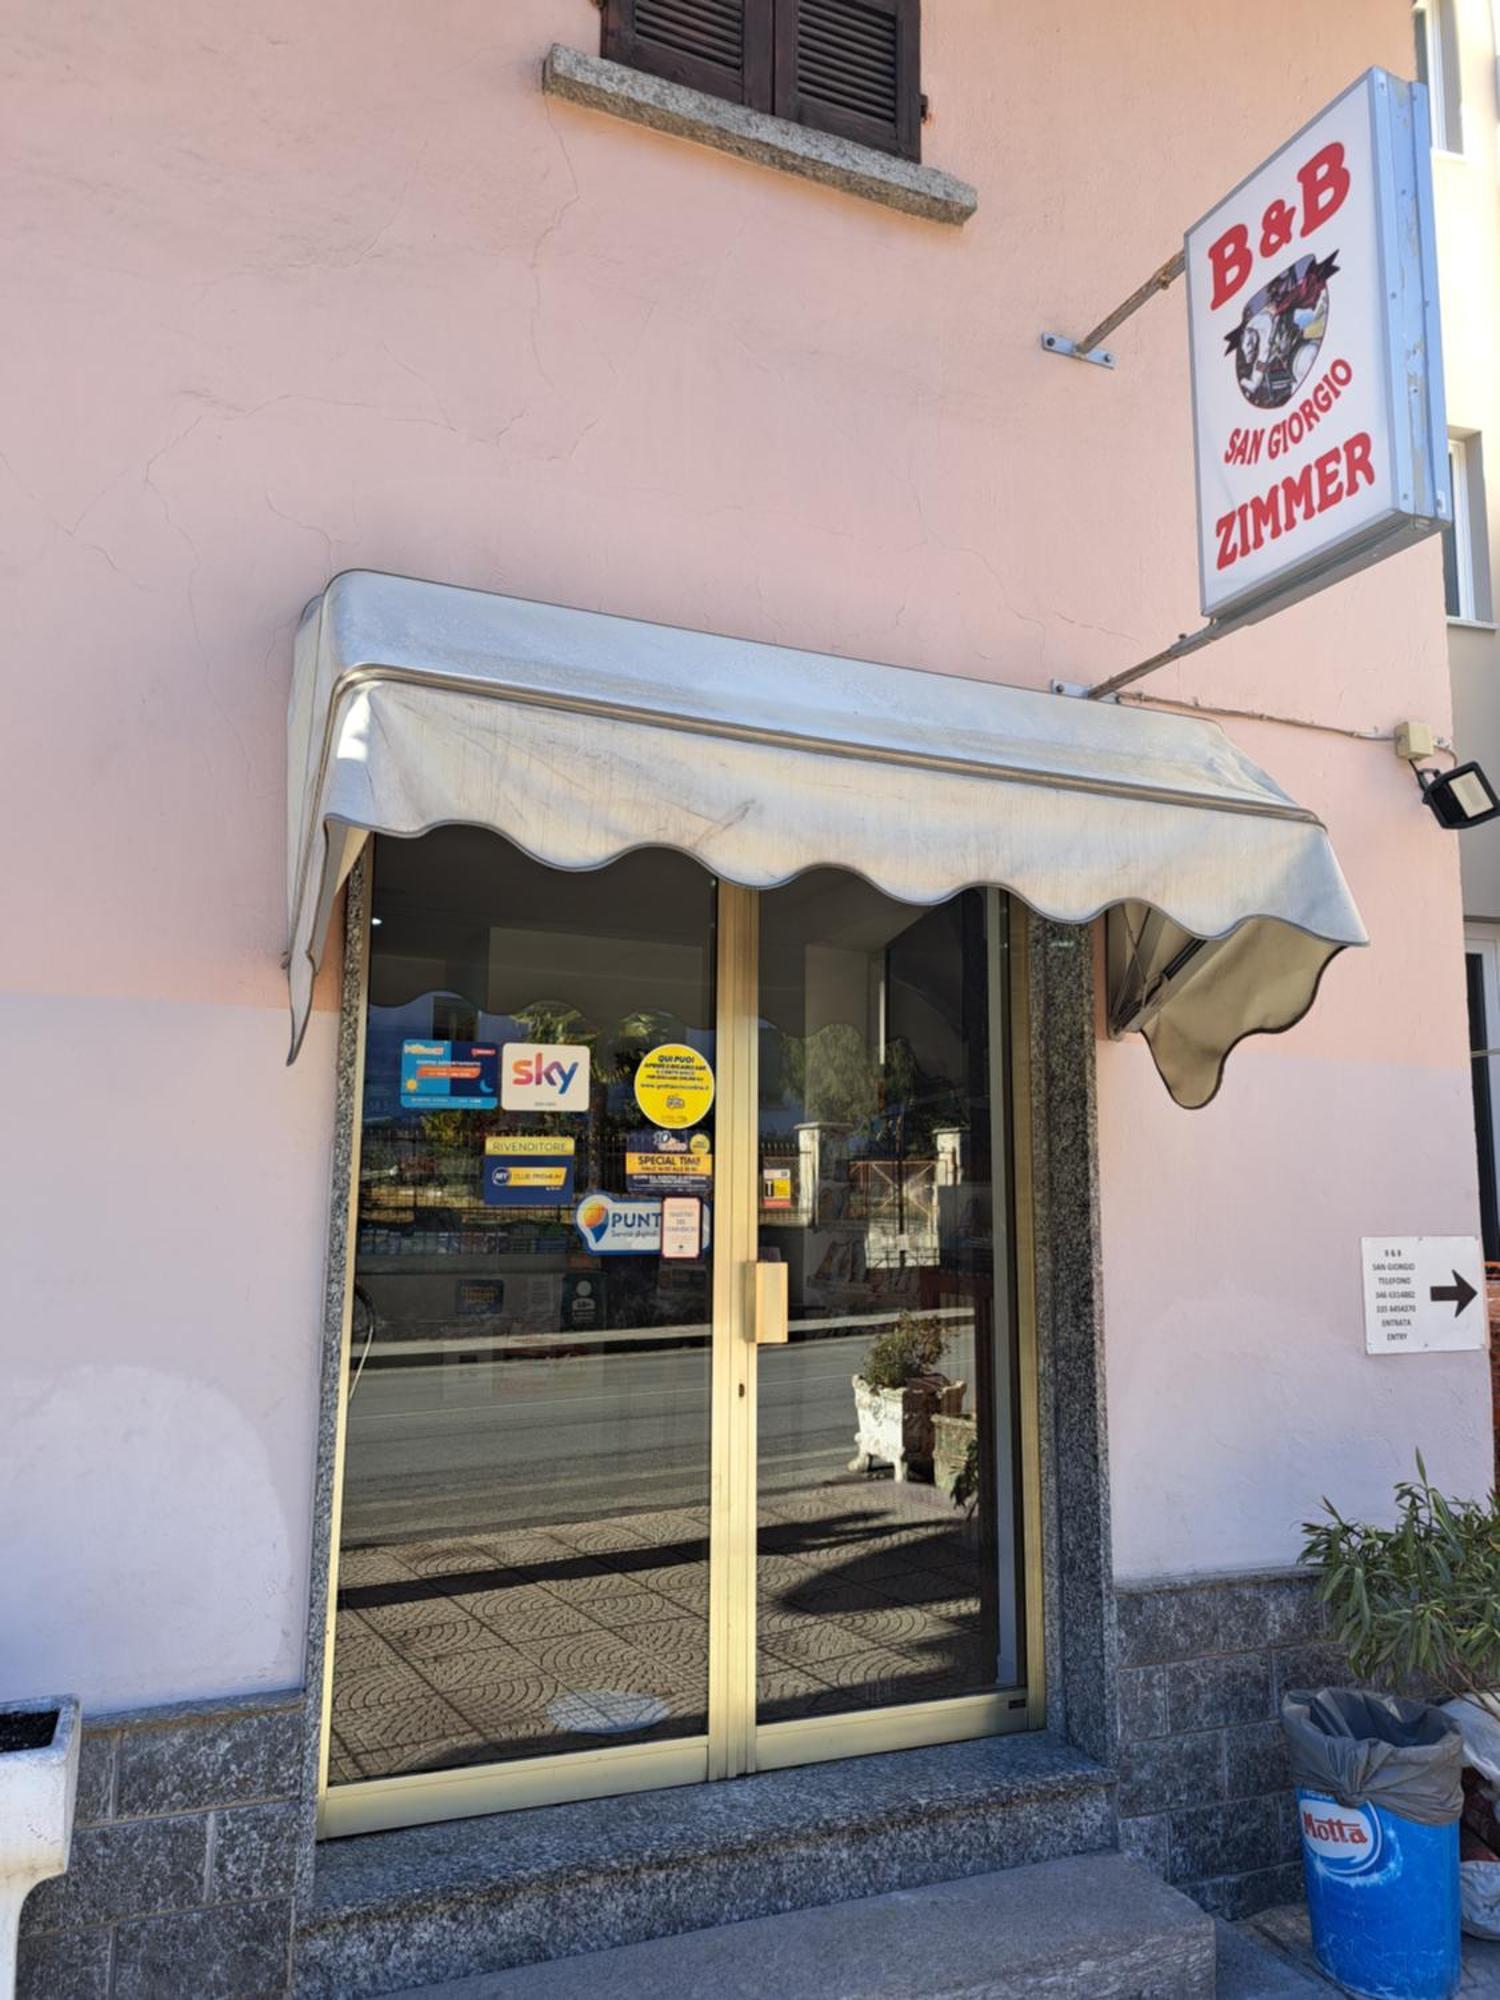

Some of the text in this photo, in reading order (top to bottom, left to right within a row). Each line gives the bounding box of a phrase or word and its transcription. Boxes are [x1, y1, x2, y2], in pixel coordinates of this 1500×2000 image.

[1208, 141, 1352, 310] B&B
[1223, 357, 1353, 466] SAN GIORGIO
[1214, 430, 1377, 571] ZIMMER
[657, 1055, 673, 1063] QUI
[512, 1052, 579, 1095] sky
[492, 1141, 567, 1152] RIVENDITORE
[638, 1155, 701, 1165] SPECIAL TIME
[611, 1212, 662, 1228] PUNT
[1372, 1263, 1416, 1271] SAN GIORGIO
[1378, 1277, 1412, 1285] TELEFONO
[1381, 1319, 1412, 1327] ENTRATA
[1386, 1333, 1408, 1341] ENTRY
[1303, 1811, 1369, 1844] Motta
